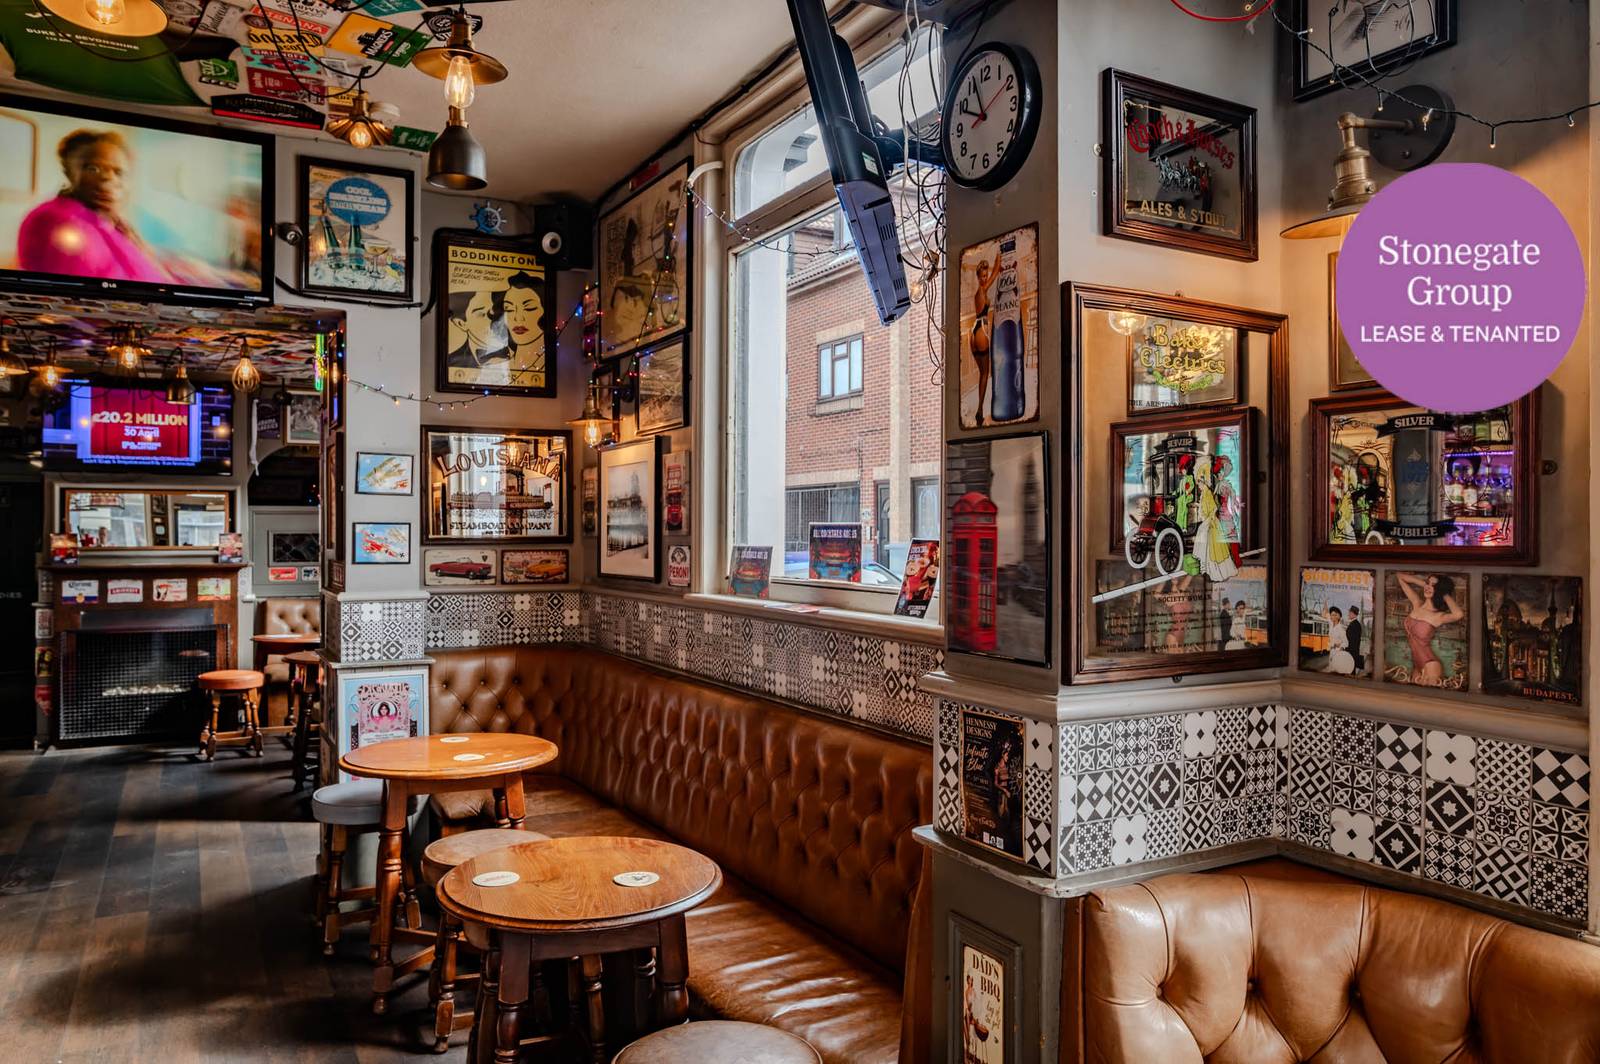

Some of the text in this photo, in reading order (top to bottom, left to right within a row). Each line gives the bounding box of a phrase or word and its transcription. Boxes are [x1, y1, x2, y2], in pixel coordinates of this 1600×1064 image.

[365, 29, 394, 57] MAGNERS
[980, 65, 991, 83] 12
[997, 65, 1001, 80] 1
[968, 76, 977, 97] 11
[1006, 74, 1014, 91] 2
[959, 98, 968, 115] 10
[1009, 96, 1017, 112] 3
[956, 122, 963, 138] 9
[1006, 119, 1014, 133] 4
[960, 141, 968, 157] 8
[996, 141, 1004, 157] 5
[1126, 112, 1235, 170] Coach & Horses
[970, 154, 977, 170] 7
[982, 153, 990, 168] 6
[1140, 198, 1227, 227] ALES & STOUT
[451, 250, 536, 266] BODDINGTON
[1139, 347, 1227, 374] Electrics
[135, 413, 188, 426] MILLION
[1394, 415, 1435, 428] SILVER
[124, 427, 160, 439] 30 April
[436, 447, 562, 482] LOUISIANA
[449, 522, 507, 530] STEAMBOAT
[1390, 526, 1438, 538] JUBILEE
[668, 565, 690, 578] PERONI
[1303, 569, 1371, 586] BUDAPEST
[1522, 687, 1574, 701] BUDAPEST
[966, 716, 998, 731] HENNESSY
[966, 726, 993, 740] DESIGNS
[972, 953, 999, 980] DAD'S
[980, 975, 1001, 1002] BBQ
